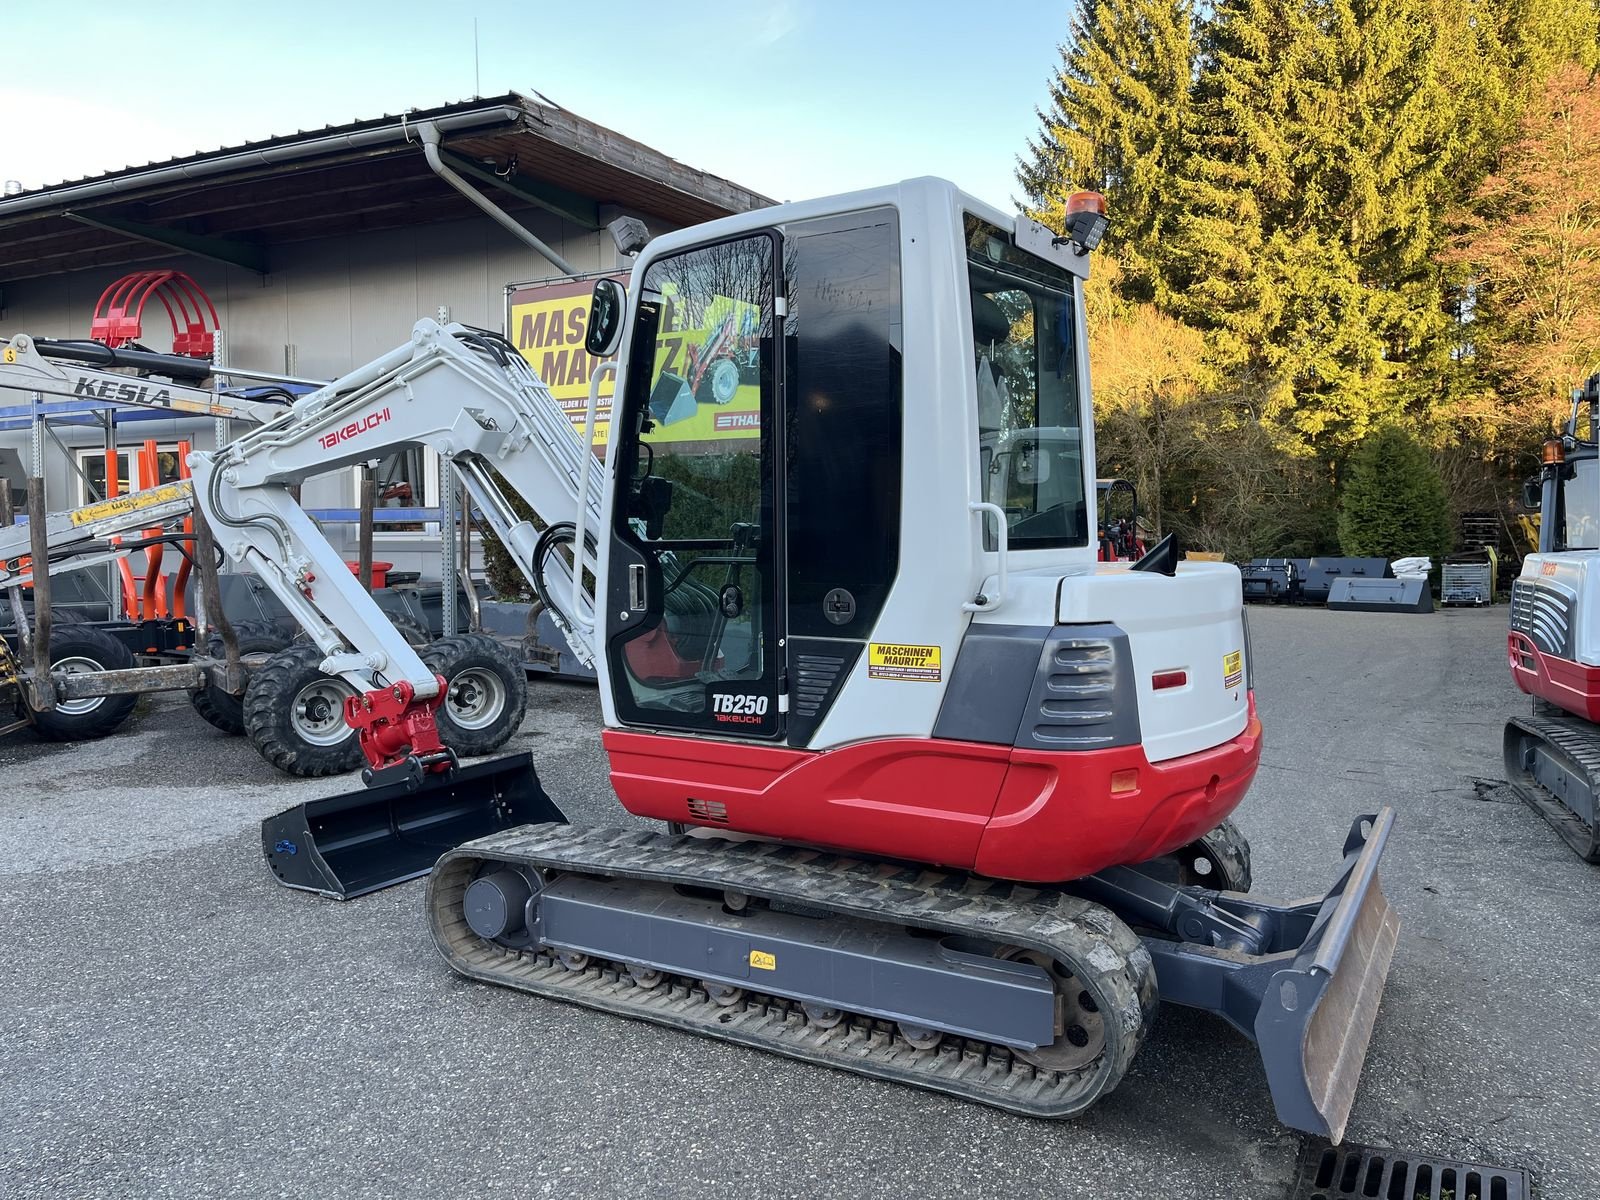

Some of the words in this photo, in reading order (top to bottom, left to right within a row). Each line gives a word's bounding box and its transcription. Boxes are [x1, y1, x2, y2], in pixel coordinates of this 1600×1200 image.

[73, 377, 171, 407] KESLA
[318, 407, 391, 449] TAKEUCHI
[877, 645, 934, 658] MASCHINEN
[883, 656, 926, 667] MAURITZ
[712, 694, 769, 715] TB250
[714, 714, 762, 724] TAKEUCHI
